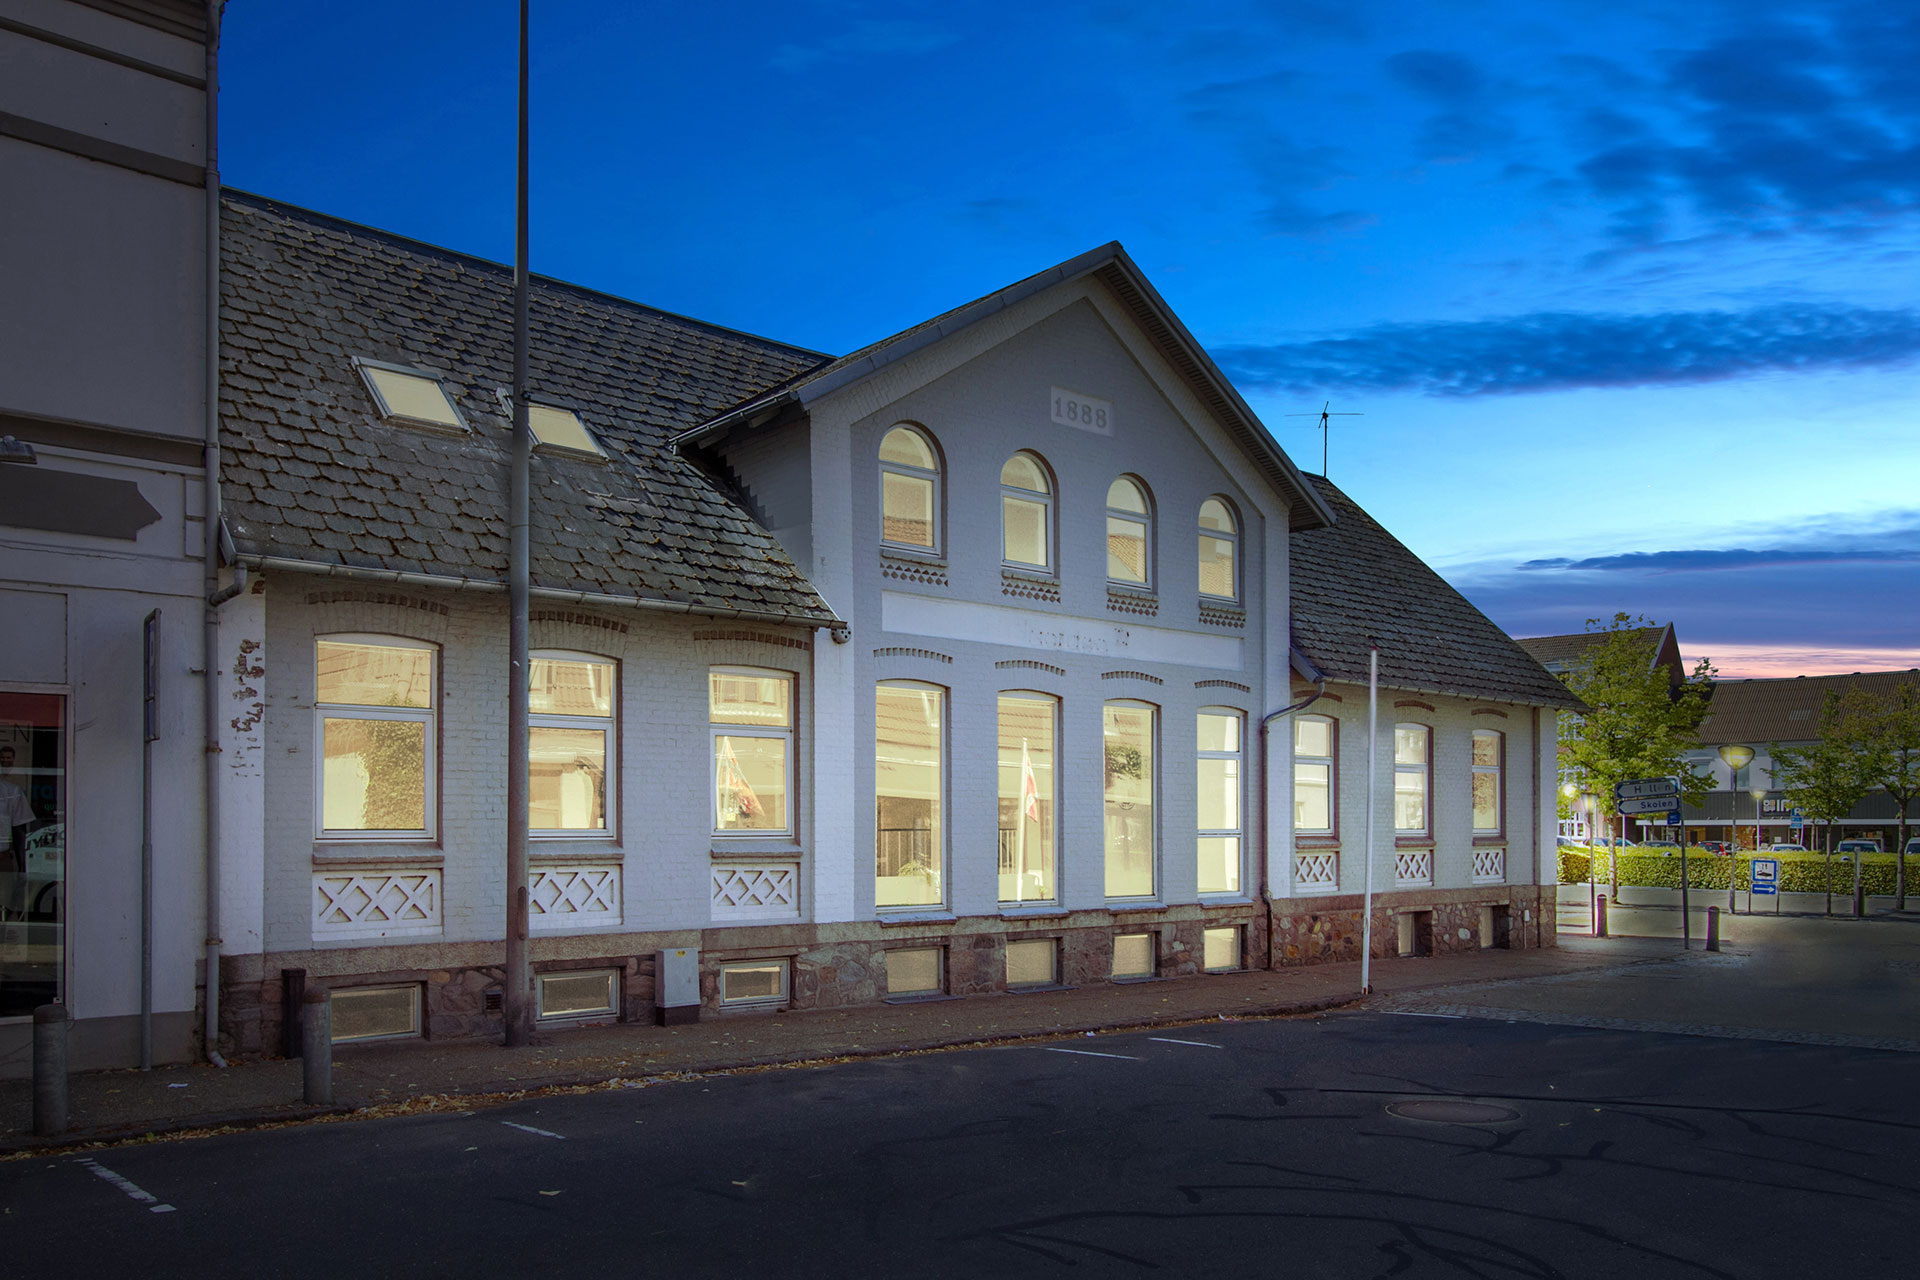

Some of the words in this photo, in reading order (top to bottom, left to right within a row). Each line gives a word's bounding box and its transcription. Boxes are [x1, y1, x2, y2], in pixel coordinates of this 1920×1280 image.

[1055, 397, 1107, 428] 1888
[1634, 784, 1671, 794] Hlln
[1640, 801, 1673, 809] Skolen
